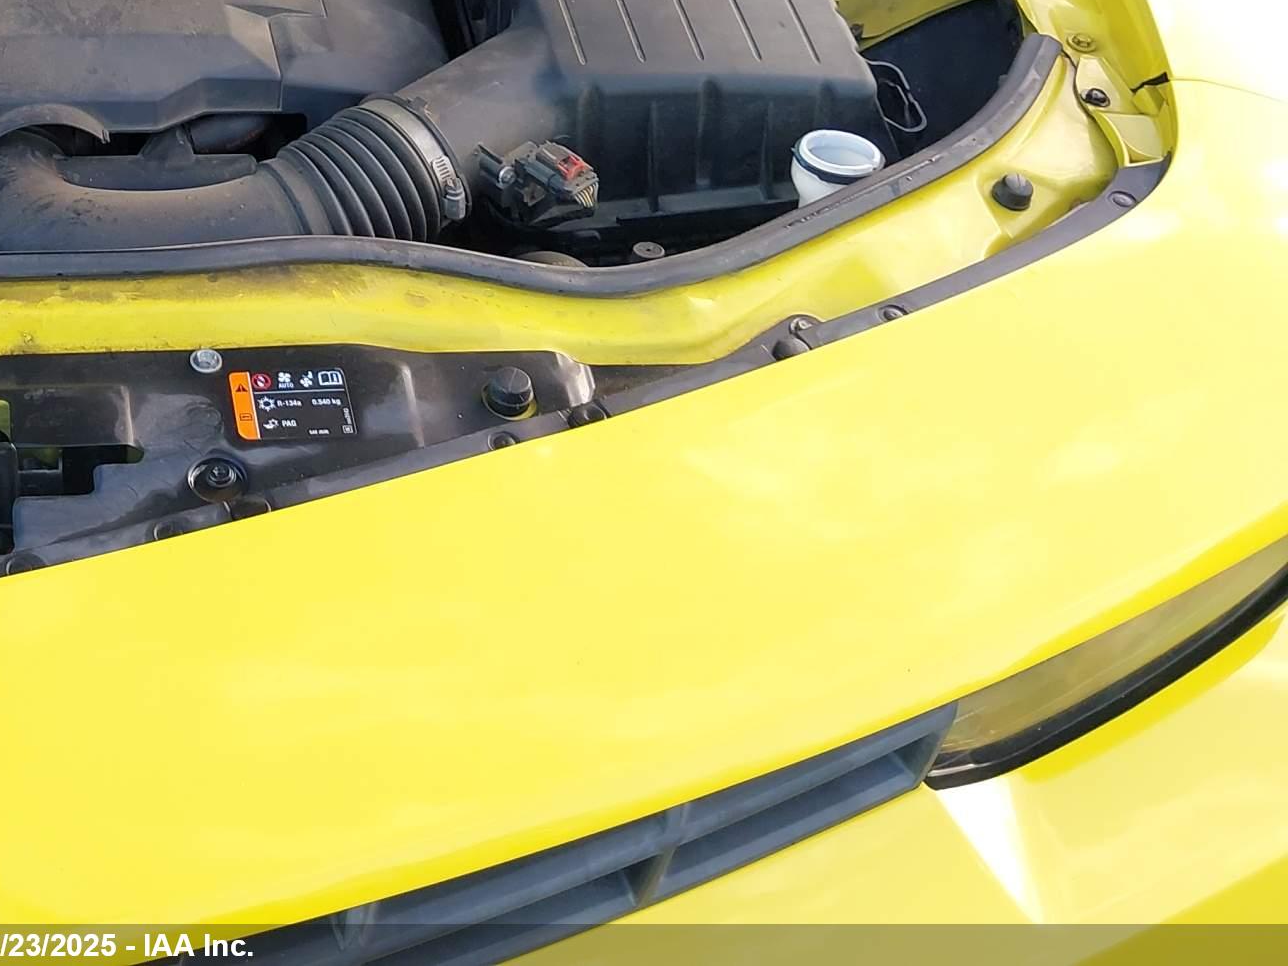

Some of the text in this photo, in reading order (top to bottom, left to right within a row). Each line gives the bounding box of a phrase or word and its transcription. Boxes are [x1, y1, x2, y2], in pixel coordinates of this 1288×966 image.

[276, 399, 302, 407] R-134a
[331, 397, 341, 406] kg
[281, 419, 297, 427] PAG
